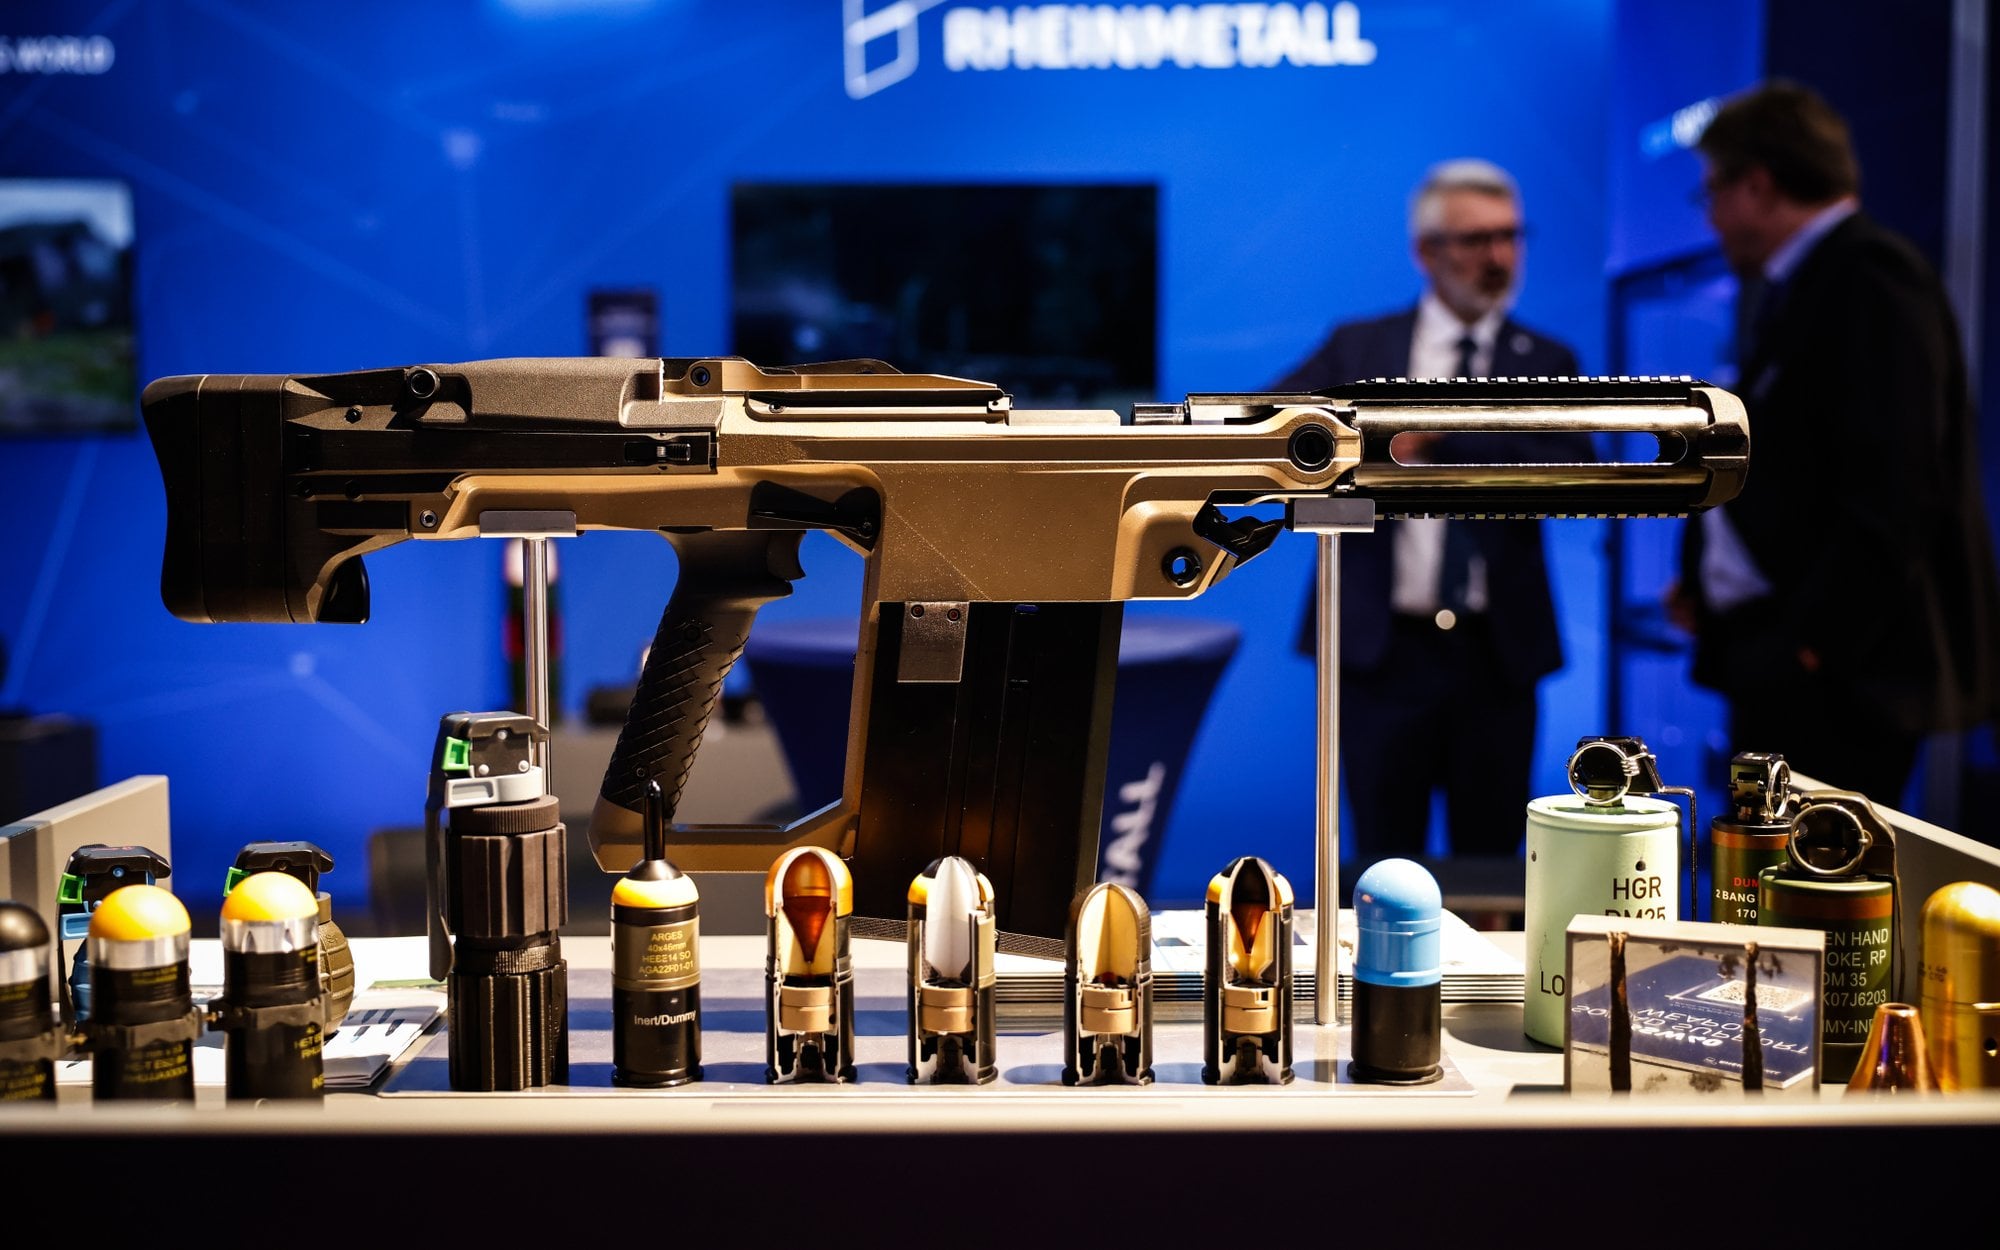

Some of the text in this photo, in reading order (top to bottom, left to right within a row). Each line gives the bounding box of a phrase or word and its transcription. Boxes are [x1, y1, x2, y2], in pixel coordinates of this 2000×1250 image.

[943, 1, 1377, 71] RHEINMETALL
[17, 35, 115, 74] WORLD
[1613, 876, 1662, 900] HGR
[1715, 888, 1756, 903] 2 BANG
[1736, 908, 1757, 919] 170
[651, 930, 683, 941] ARGES
[1851, 928, 1889, 947] HAND
[1870, 949, 1887, 966] RP
[1540, 971, 1565, 996] LO
[1850, 972, 1868, 987] 35
[634, 1010, 697, 1026] Inert/Dummy
[1823, 1019, 1873, 1034] MY-IN
